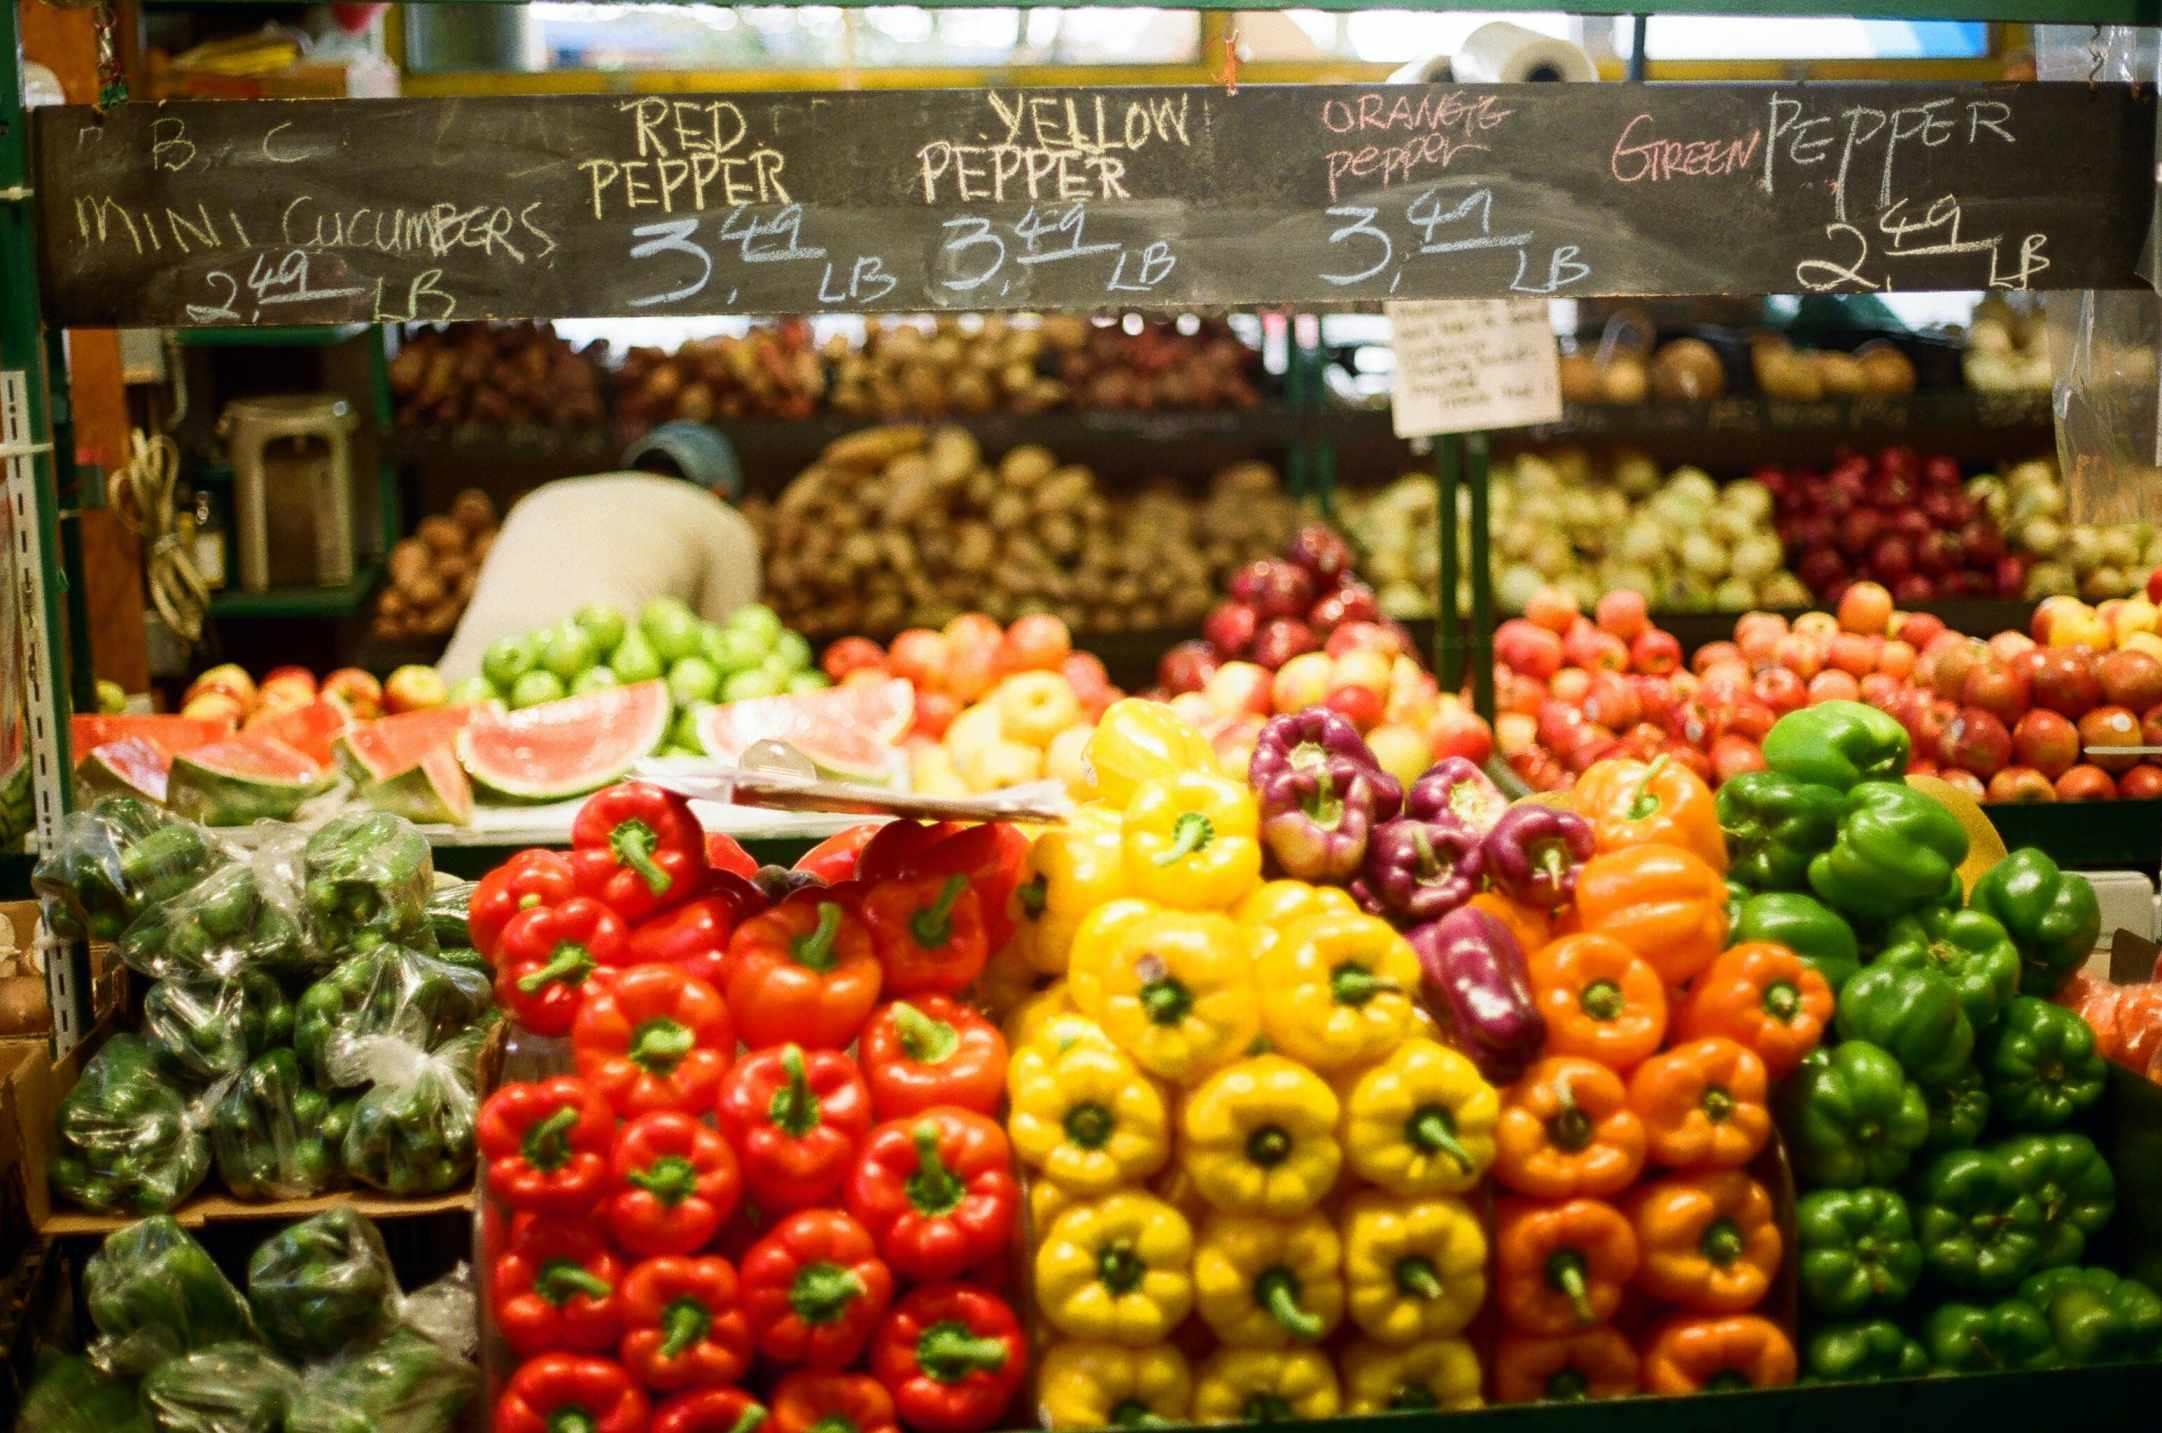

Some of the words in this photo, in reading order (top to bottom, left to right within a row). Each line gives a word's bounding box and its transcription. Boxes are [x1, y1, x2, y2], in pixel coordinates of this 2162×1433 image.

[620, 96, 748, 157] RED
[987, 90, 1190, 153] YELLOW
[1322, 91, 1515, 137] ORANGE
[578, 150, 791, 220] PEPPER
[917, 141, 1131, 203] PEPPER
[1611, 114, 1760, 182] GREEN
[1761, 91, 2017, 222] PEPPER
[75, 194, 252, 254] MINI
[818, 255, 898, 302] LB
[1106, 241, 1176, 292] LB
[1510, 246, 1592, 294] LB
[1989, 233, 2051, 290] LB
[372, 268, 457, 323] LB
